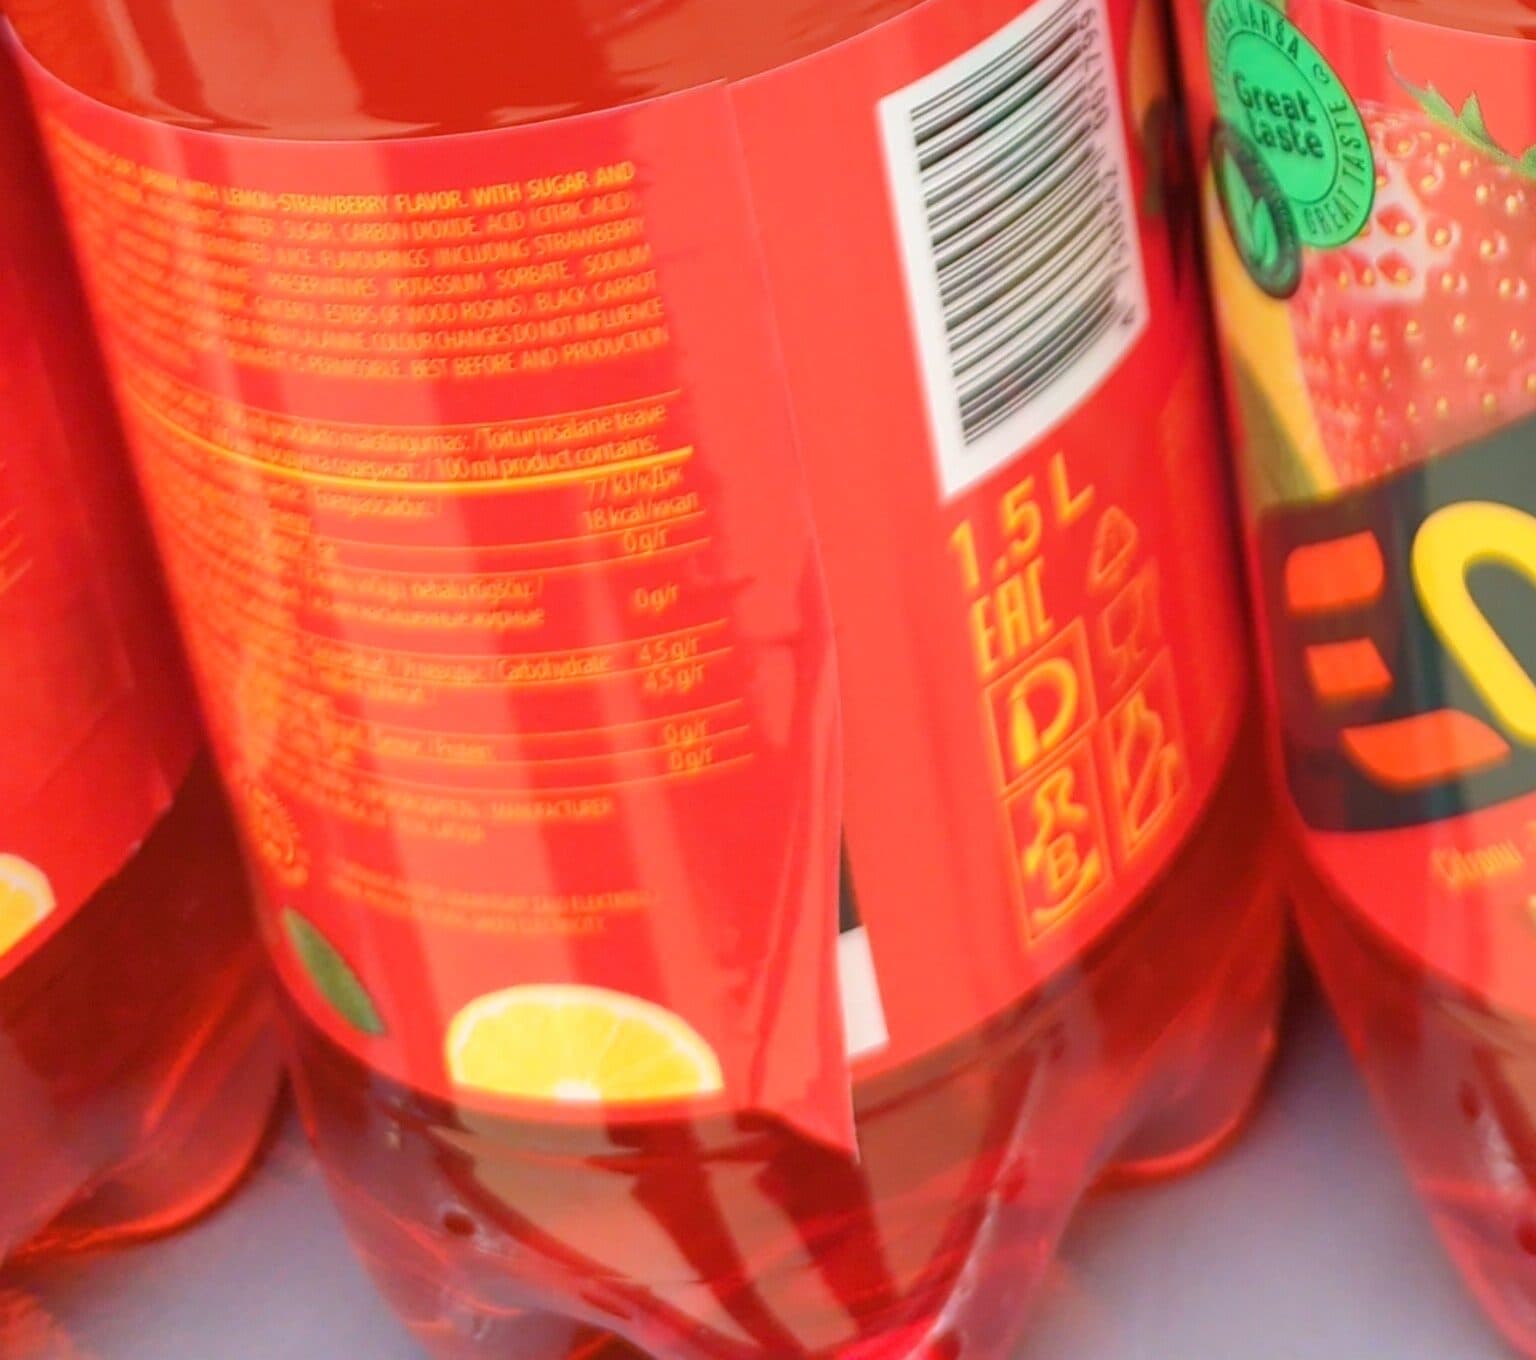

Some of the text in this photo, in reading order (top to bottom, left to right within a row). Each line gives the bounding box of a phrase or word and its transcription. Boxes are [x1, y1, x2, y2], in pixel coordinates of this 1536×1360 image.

[1232, 69, 1318, 124] Great
[1251, 118, 1326, 160] taste
[470, 182, 522, 208] WITH
[526, 171, 590, 200] SUGAR
[594, 160, 637, 188] AND
[1303, 98, 1367, 236] GREAT TASTE
[501, 447, 572, 480] product
